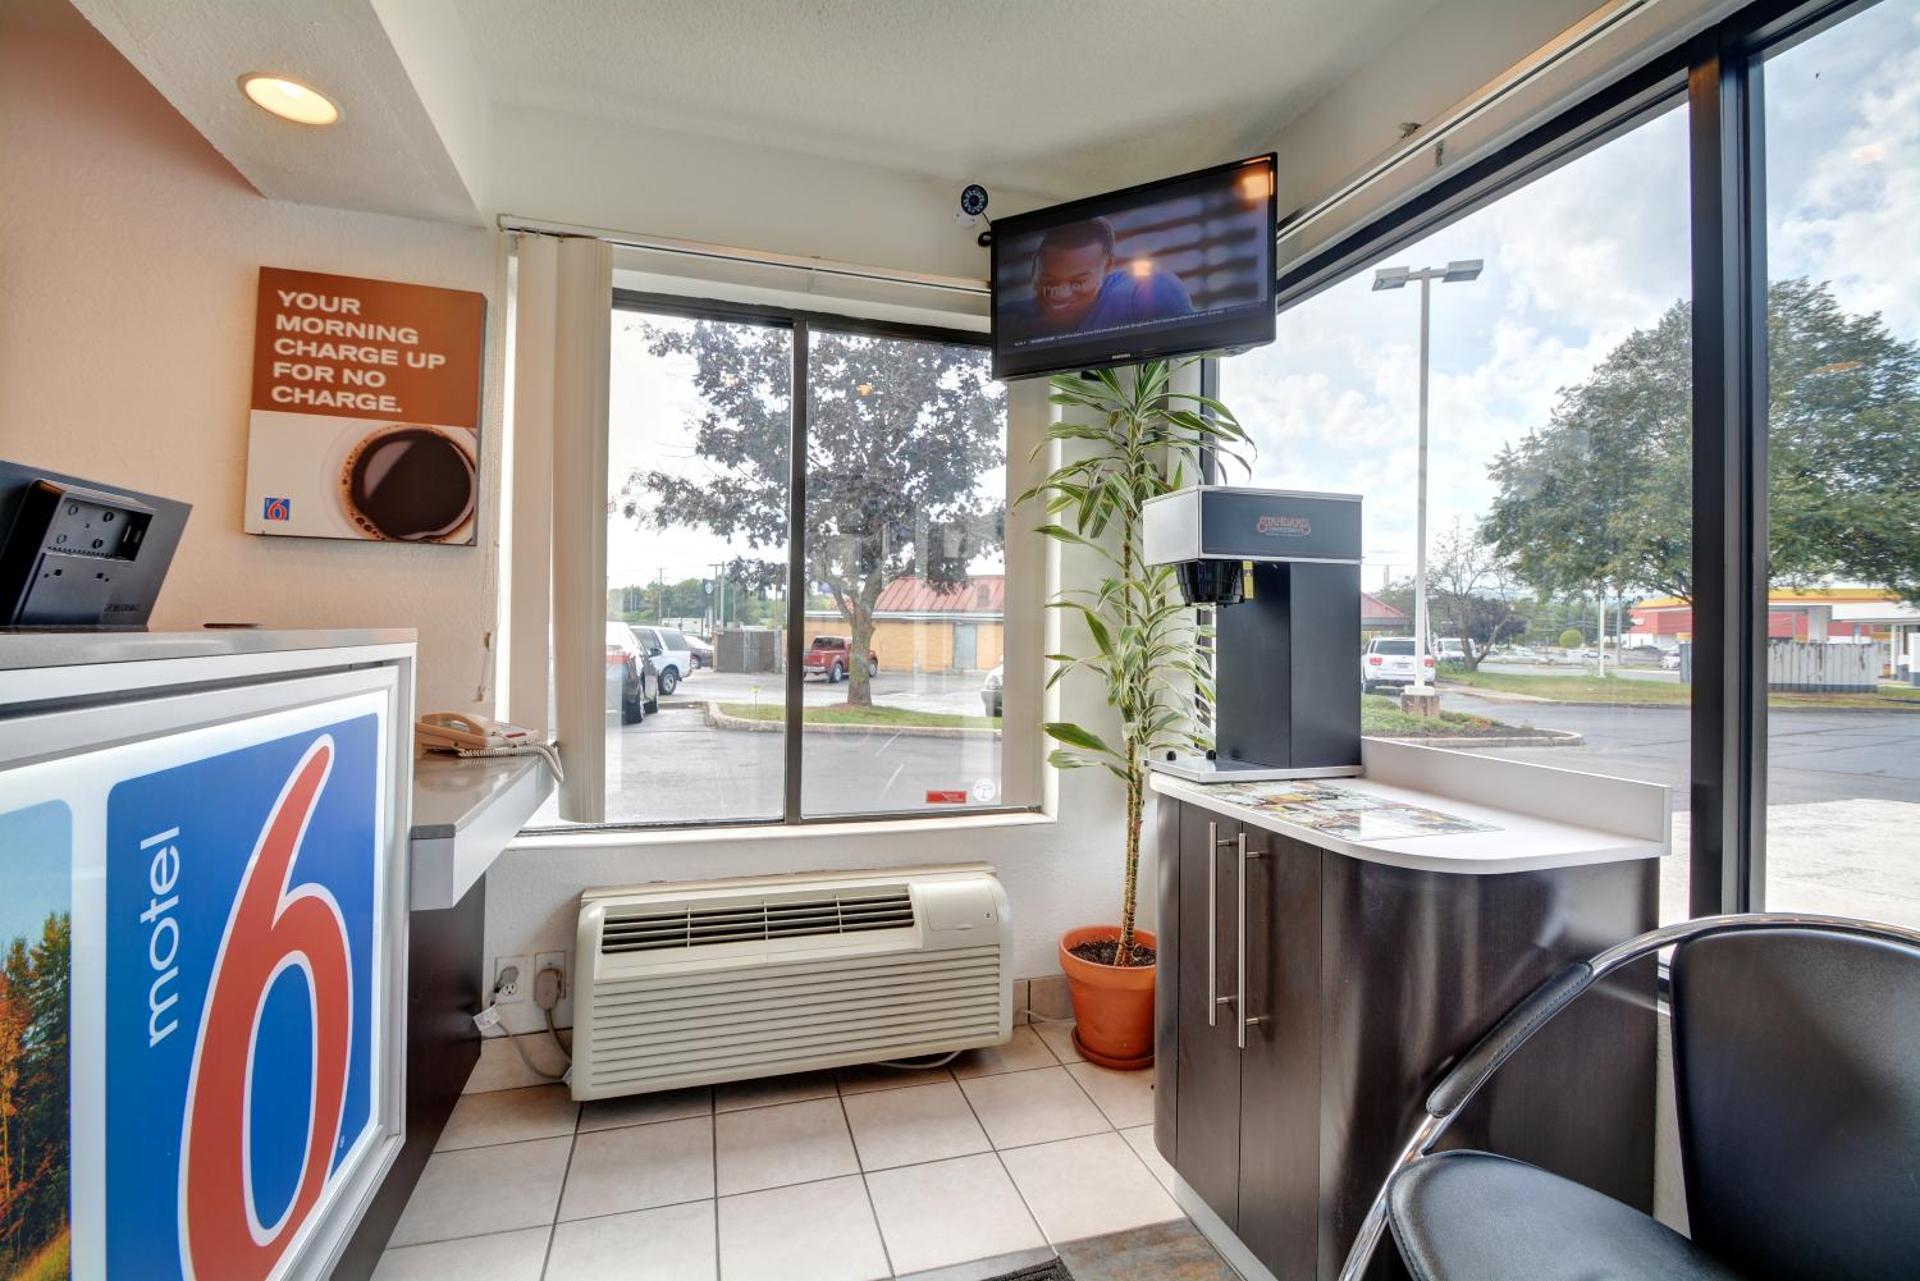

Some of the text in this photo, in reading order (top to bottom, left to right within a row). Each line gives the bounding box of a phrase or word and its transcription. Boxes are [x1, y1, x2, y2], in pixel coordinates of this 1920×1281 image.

[277, 290, 361, 315] YOUR
[275, 314, 419, 344] MORNING
[274, 338, 446, 369] CHARGE UP
[272, 362, 386, 387] FOR NO
[271, 386, 402, 412] CHARGE.
[140, 826, 180, 1049] motel
[177, 733, 354, 1281] 6
